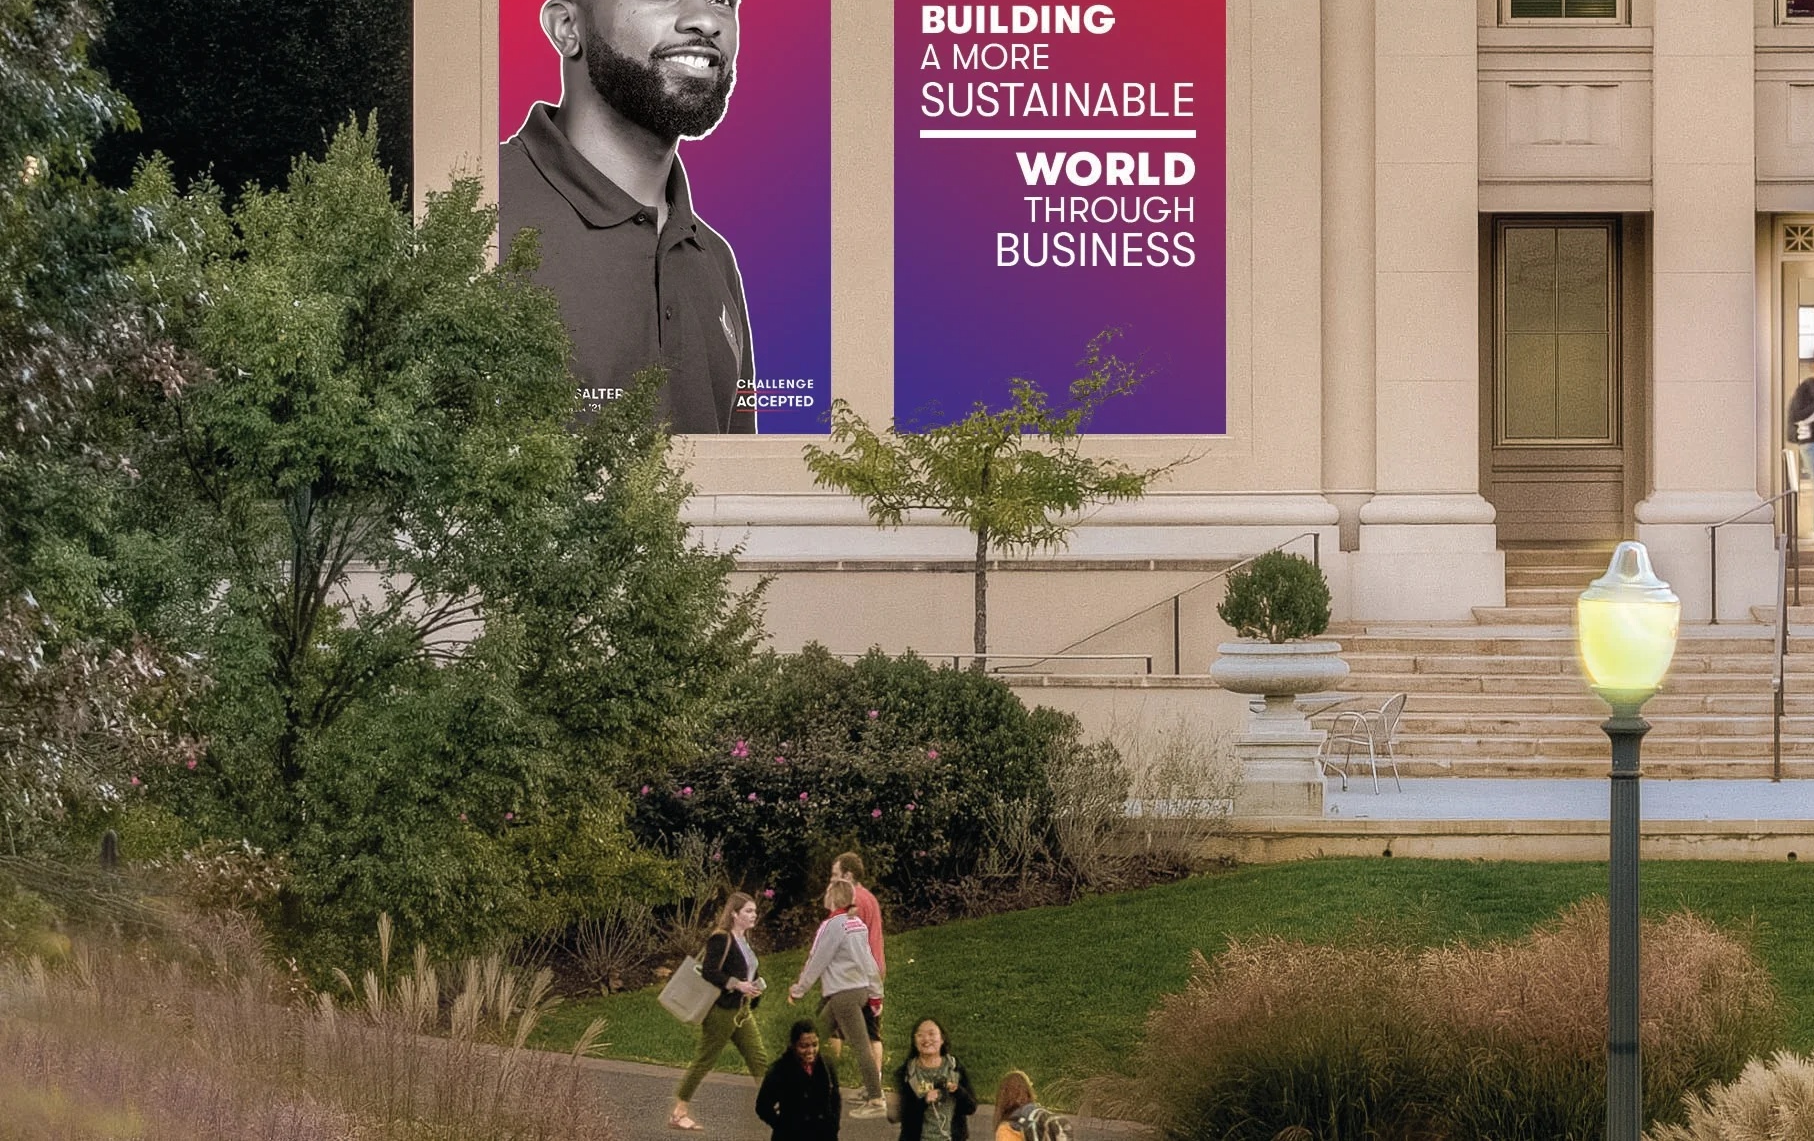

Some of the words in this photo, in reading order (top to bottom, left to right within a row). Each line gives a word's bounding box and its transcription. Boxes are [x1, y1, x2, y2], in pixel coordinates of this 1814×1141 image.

[921, 4, 1116, 35] BUILDING
[920, 43, 941, 70] A
[953, 42, 1049, 71] MORE
[921, 81, 1194, 118] SUSTAINABLE
[1015, 151, 1196, 187] WORLD
[1023, 195, 1194, 224] THROUGH
[996, 231, 1196, 268] BUSINESS
[736, 379, 814, 389] CHALLENGE
[736, 395, 814, 407] ACCEPTED
